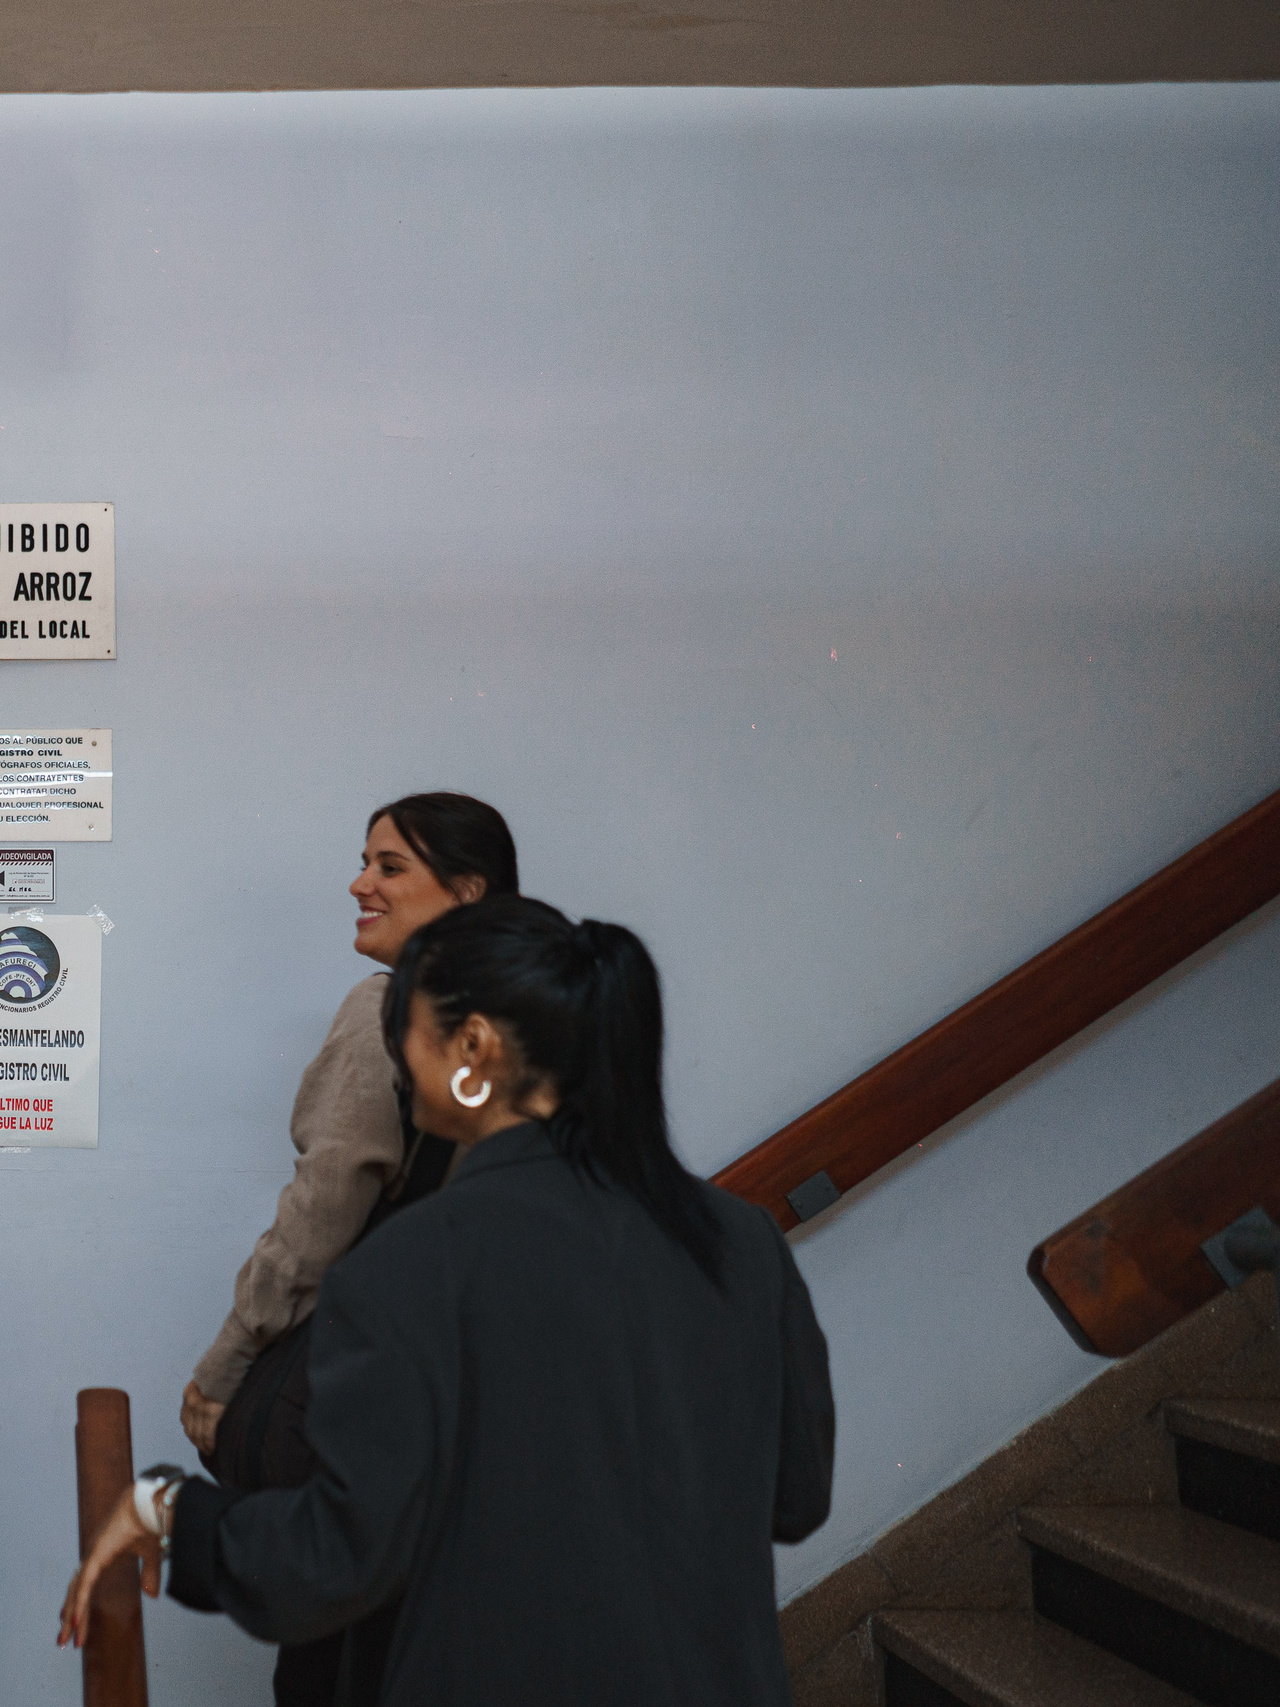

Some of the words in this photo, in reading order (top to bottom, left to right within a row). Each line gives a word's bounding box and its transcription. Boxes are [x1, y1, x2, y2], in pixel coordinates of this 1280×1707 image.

[13, 571, 92, 601] ARROZ
[0, 620, 29, 639] DEL
[38, 620, 90, 639] LOCAL
[12, 737, 23, 745] AL
[25, 736, 63, 745] PÚBLICO
[65, 737, 83, 745] QUE
[37, 749, 62, 757] CIVIL
[44, 761, 91, 770] OFICIALES,
[16, 774, 84, 782] CONTRAYENTES
[49, 787, 77, 795] DICHO
[44, 801, 104, 809] PROFESIONAL
[5, 813, 51, 822] ELECCIÓN.
[0, 957, 37, 969] AFURECI
[37, 987, 62, 1010] REGISTRO
[59, 967, 69, 987] CIVIL
[41, 1063, 70, 1081] CIVIL
[32, 1099, 54, 1112] QUE
[19, 1117, 32, 1130] LA
[34, 1117, 54, 1131] LUZ
